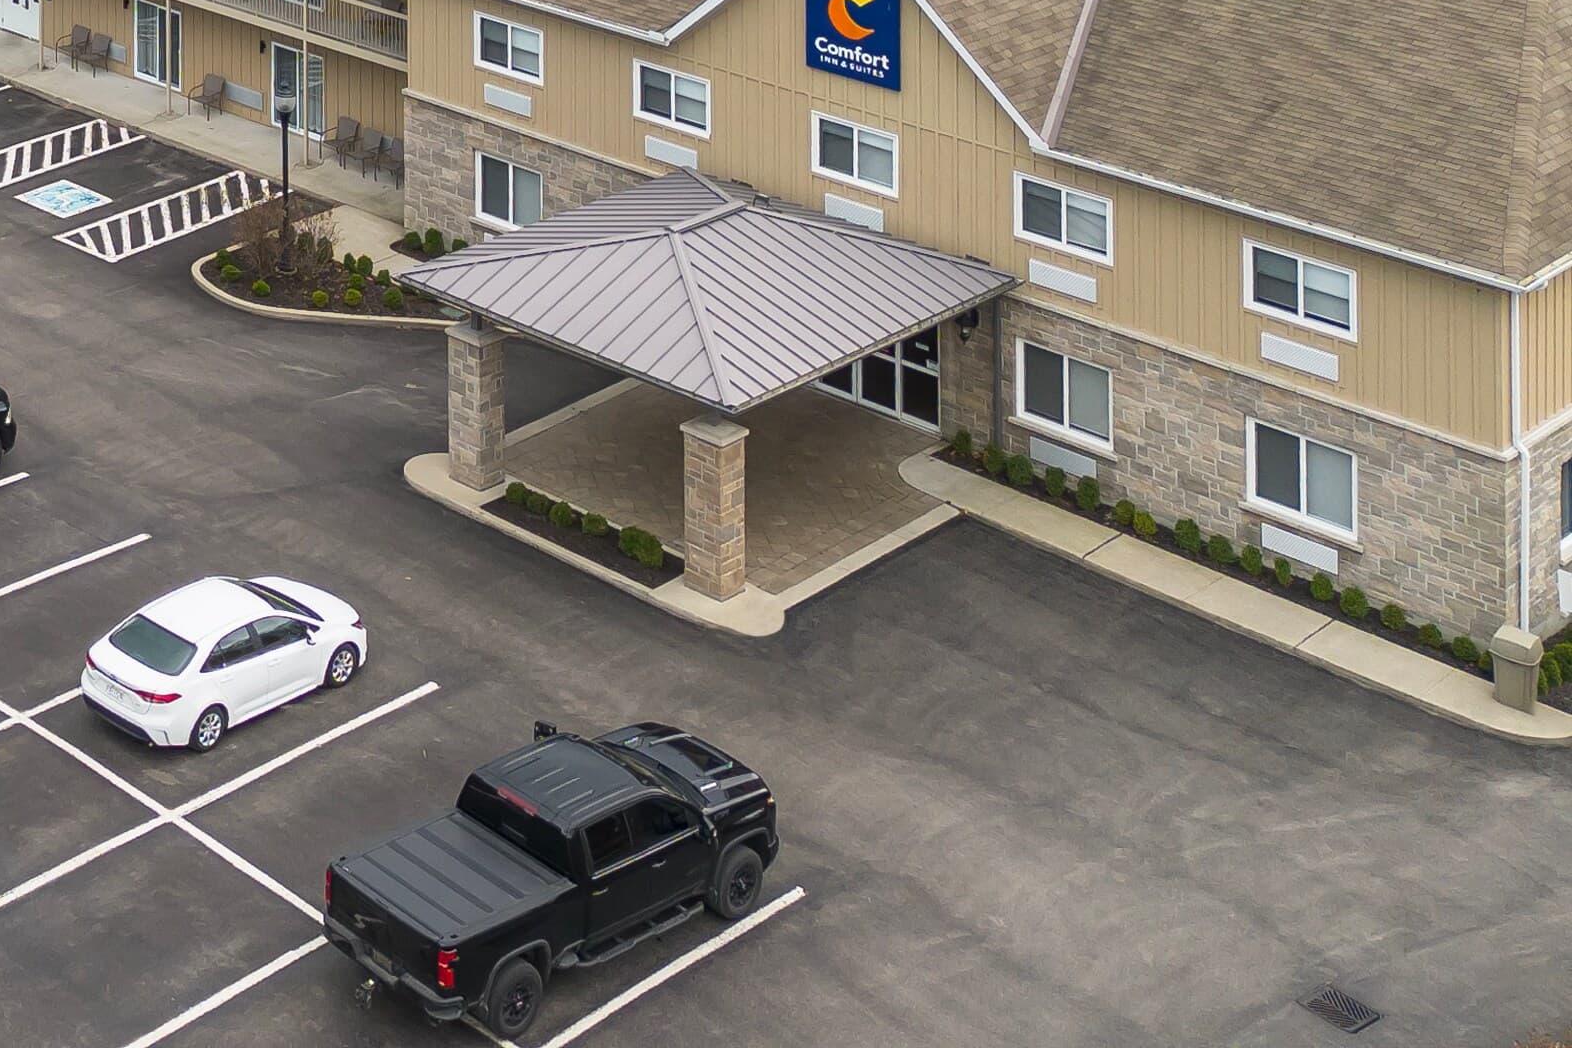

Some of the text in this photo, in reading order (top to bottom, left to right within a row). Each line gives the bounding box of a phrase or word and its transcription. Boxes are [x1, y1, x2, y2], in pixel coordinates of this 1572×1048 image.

[815, 37, 889, 70] Comfort
[820, 55, 838, 66] INN
[850, 63, 884, 78] SUITES
